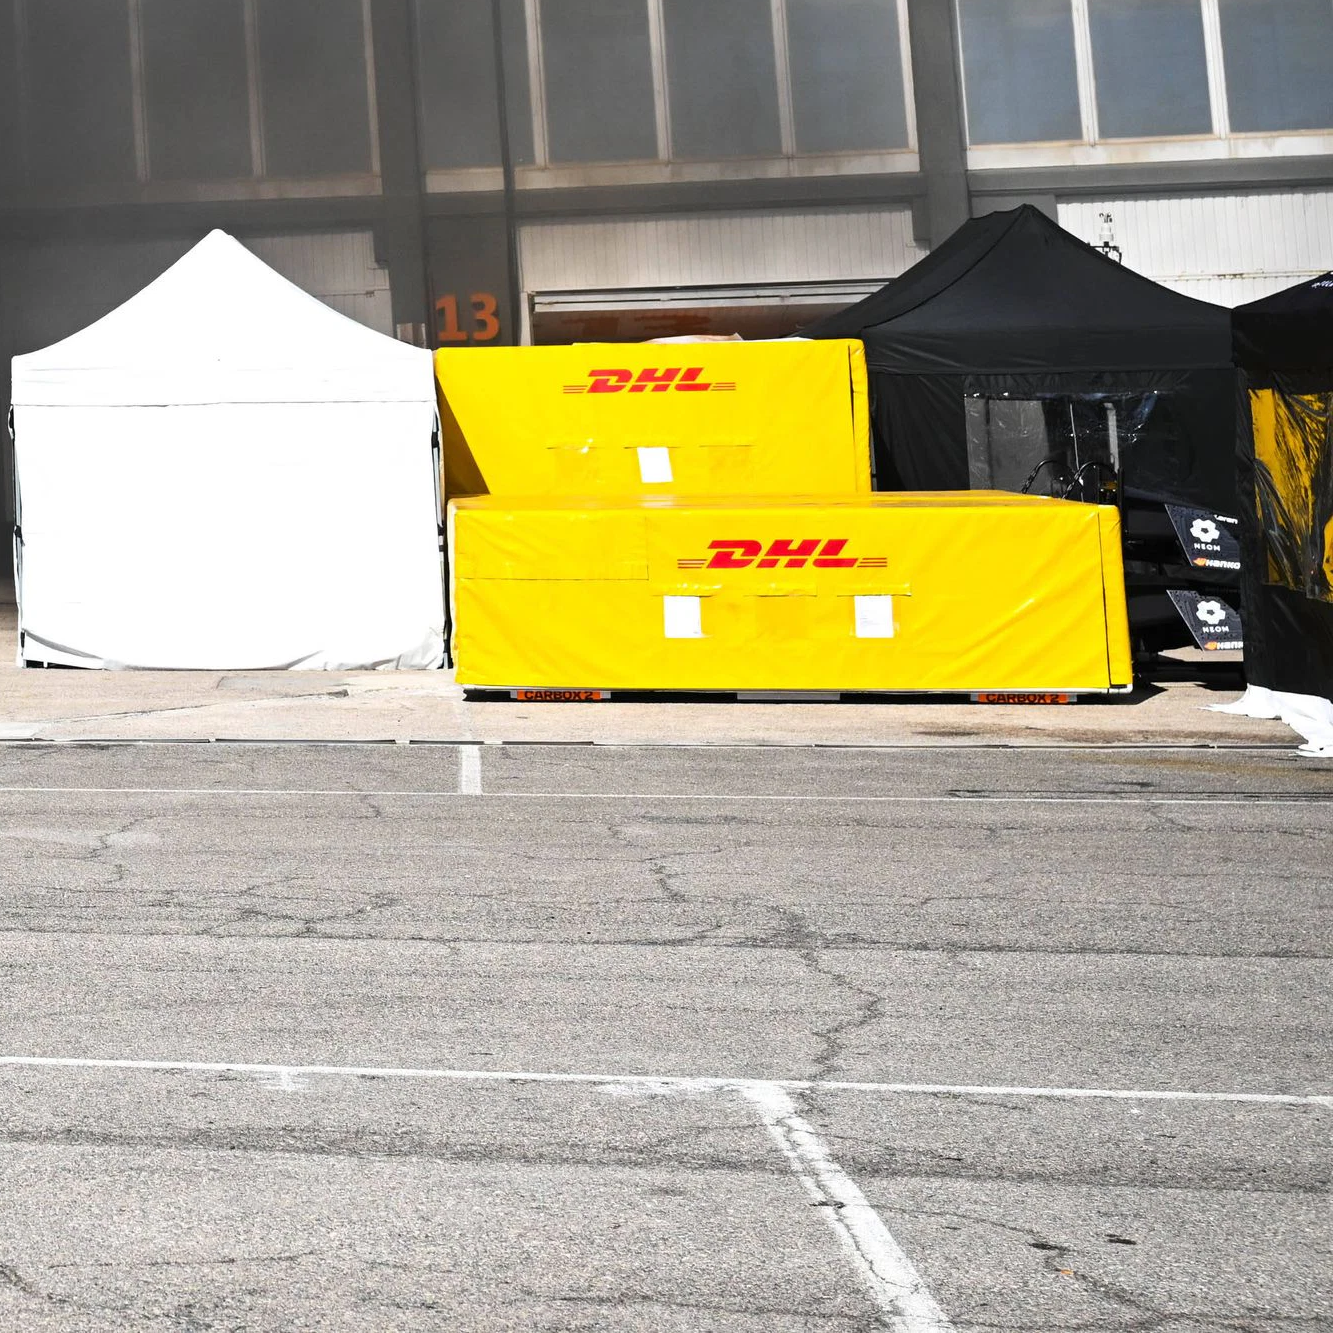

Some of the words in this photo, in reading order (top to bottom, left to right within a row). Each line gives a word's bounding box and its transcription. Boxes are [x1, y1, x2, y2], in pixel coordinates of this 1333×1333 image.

[436, 293, 499, 341] 13
[586, 367, 711, 394] DHL
[706, 539, 858, 569] DHL
[524, 690, 581, 700] CARBOX
[585, 691, 593, 700] 2
[986, 693, 1046, 703] CARBOX
[1050, 693, 1060, 702] 2
